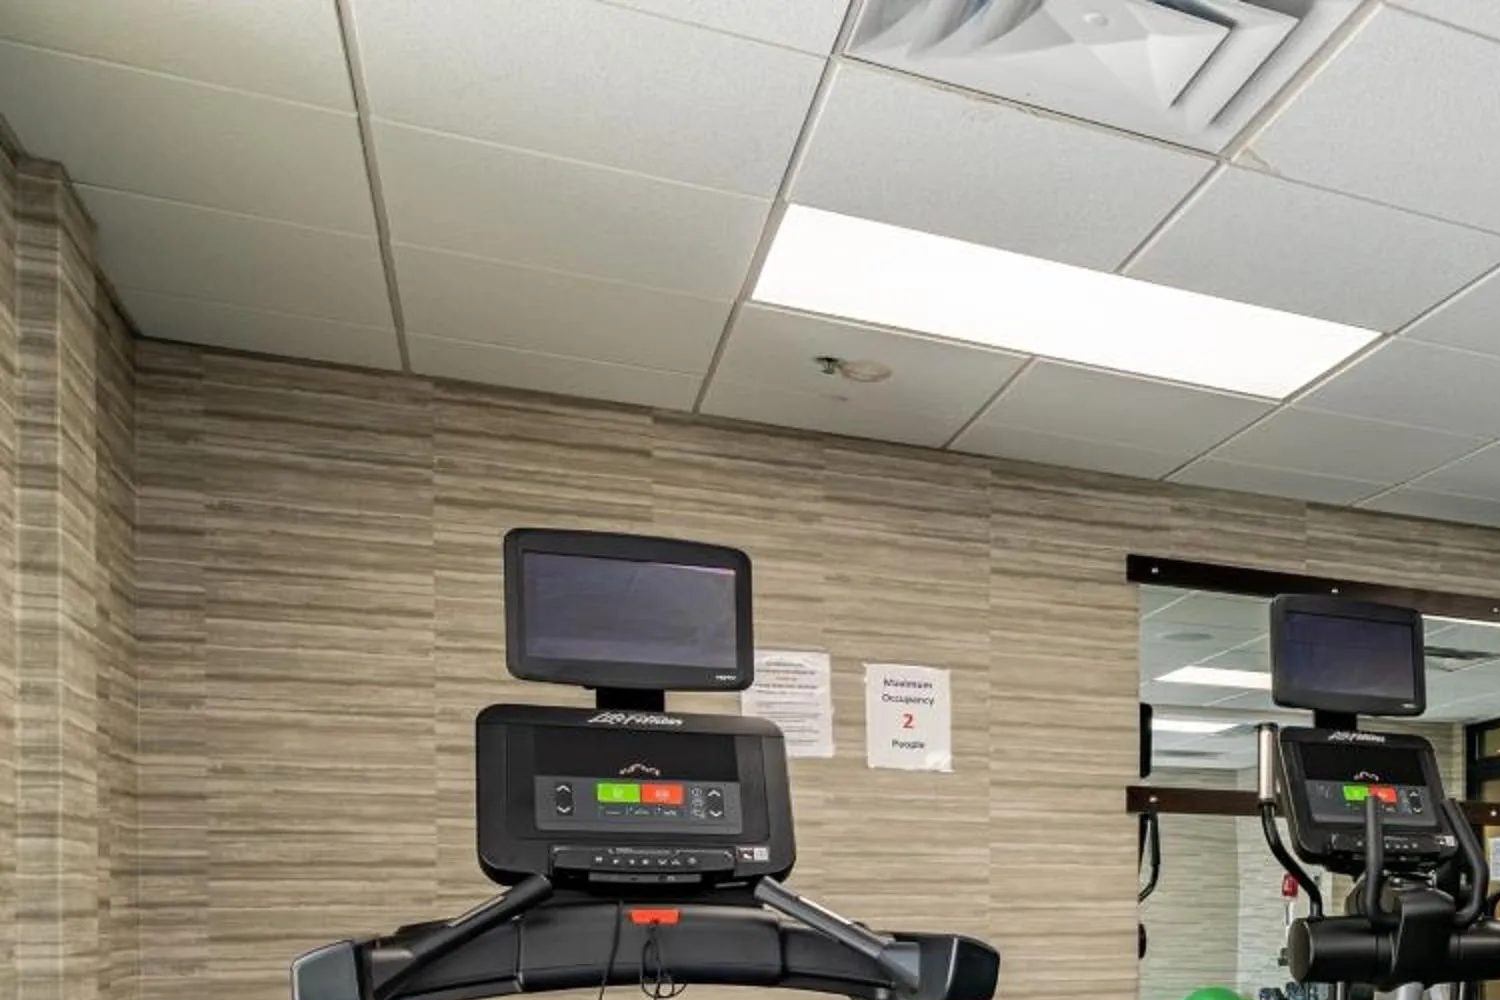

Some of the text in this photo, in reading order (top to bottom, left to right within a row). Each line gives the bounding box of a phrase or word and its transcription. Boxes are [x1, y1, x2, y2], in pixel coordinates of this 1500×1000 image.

[883, 678, 933, 689] Maximum
[881, 693, 935, 707] Occupancy
[902, 713, 914, 729] 2
[891, 739, 926, 751] People
